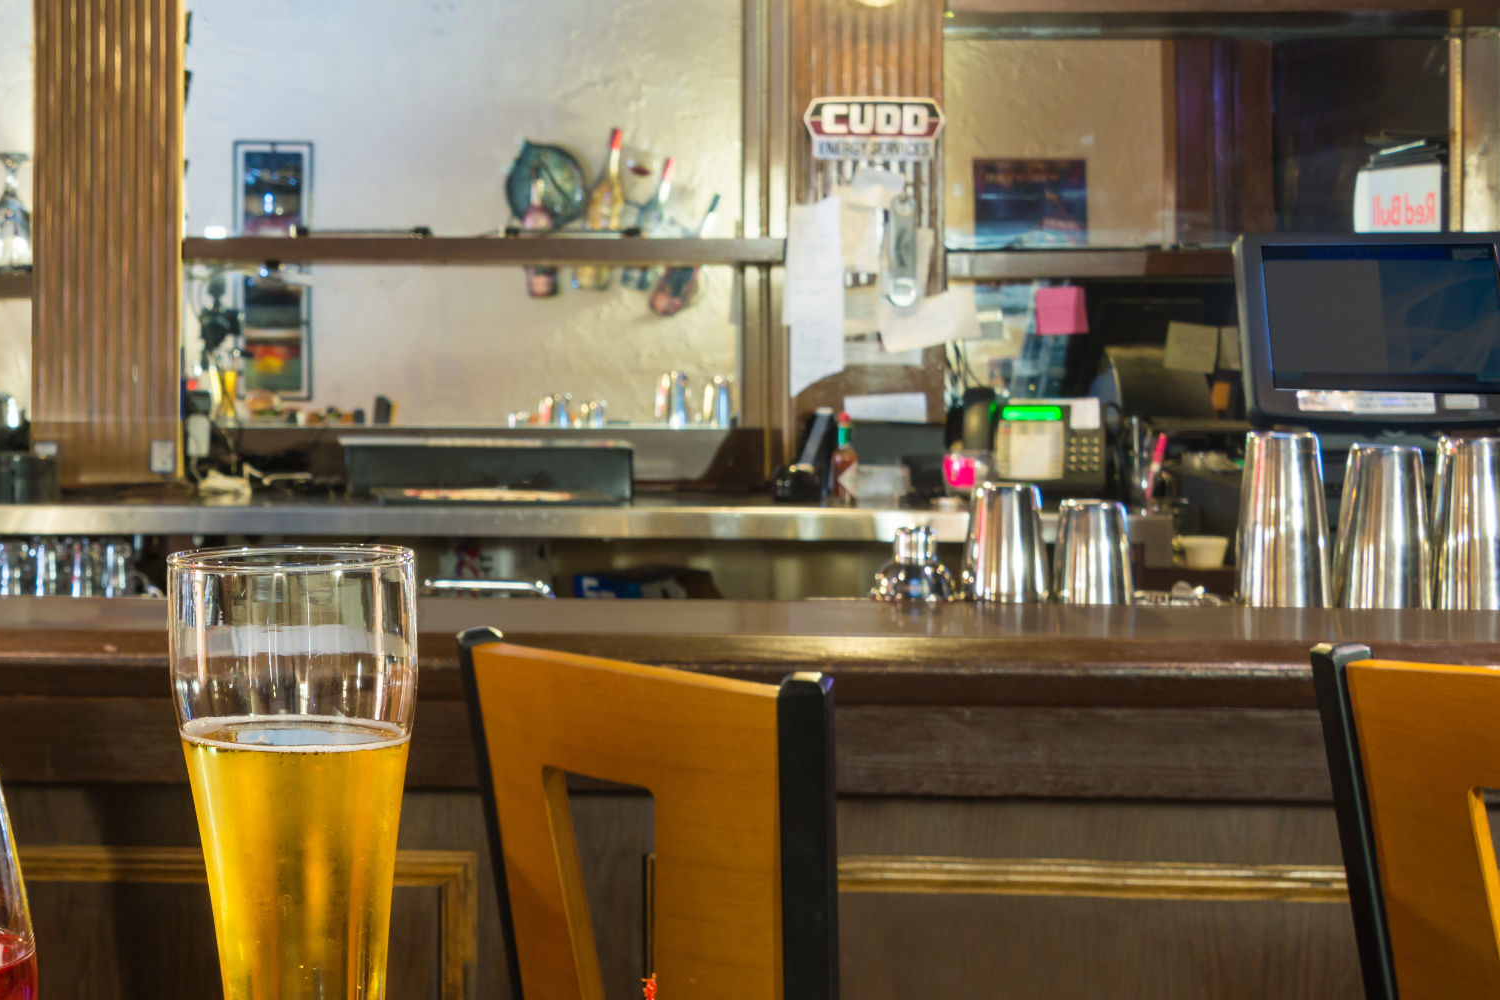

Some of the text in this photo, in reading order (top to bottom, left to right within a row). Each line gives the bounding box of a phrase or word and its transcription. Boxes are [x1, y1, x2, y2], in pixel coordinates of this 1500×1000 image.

[821, 103, 929, 135] CUDD
[818, 141, 931, 156] ENERGY SERVICES
